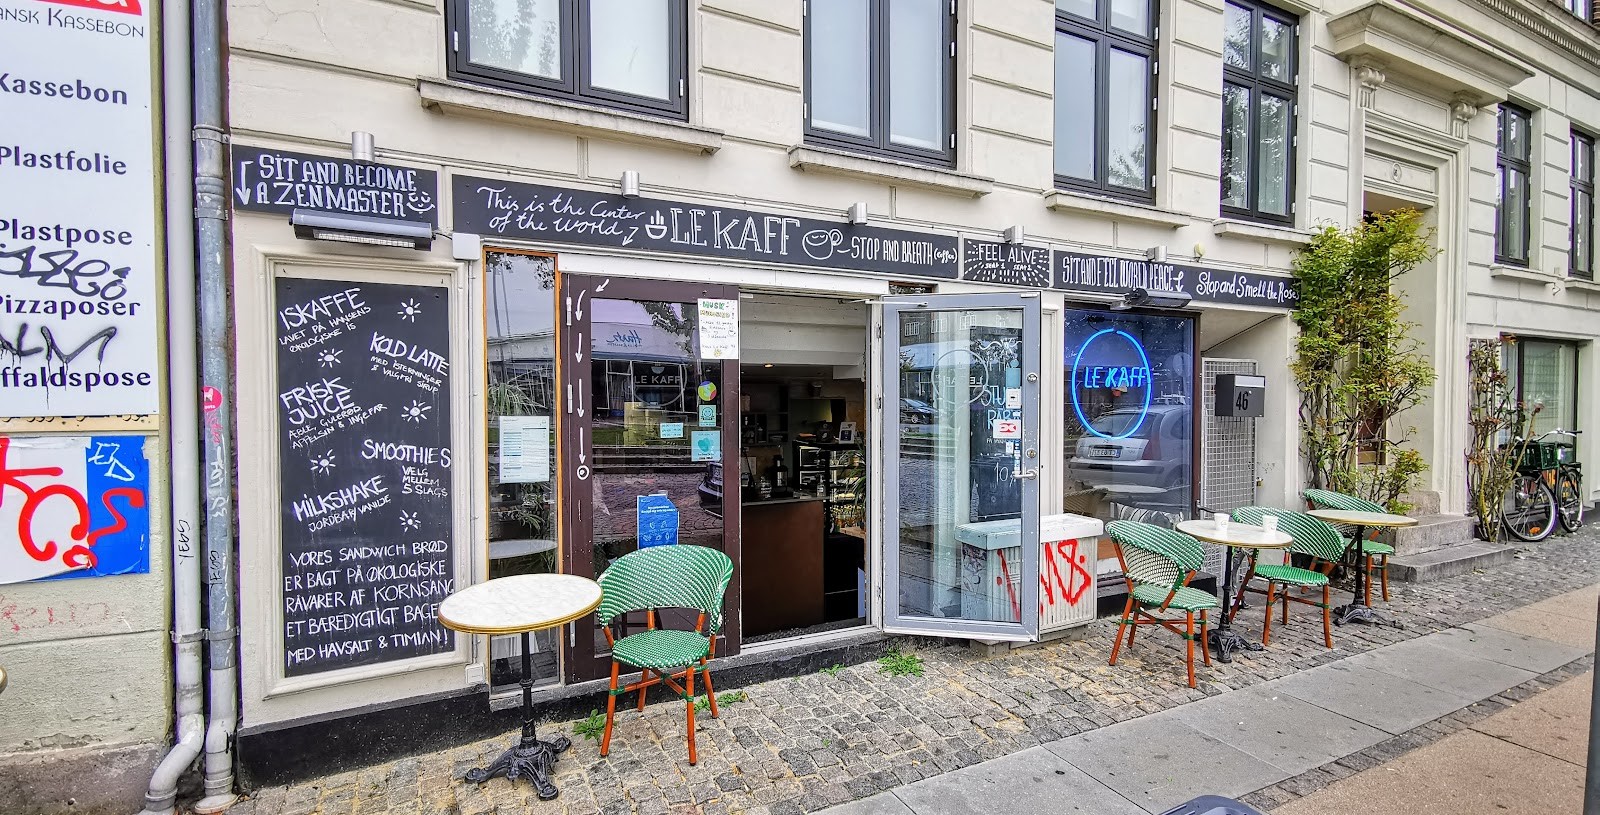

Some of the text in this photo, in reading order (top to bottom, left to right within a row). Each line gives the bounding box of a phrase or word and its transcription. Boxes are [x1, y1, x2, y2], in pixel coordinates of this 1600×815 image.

[0, 7, 40, 24] NSK
[259, 153, 417, 192] SIT AND BECOME
[476, 186, 646, 220] This is the Center
[489, 210, 512, 233] of
[516, 212, 548, 232] the
[670, 207, 801, 255] LE KAFF
[850, 236, 880, 261] STOP
[882, 239, 900, 262] AND
[901, 240, 933, 266] BREATH
[978, 243, 1040, 265] FEEL ALIVE
[1080, 258, 1096, 286] AND
[1119, 260, 1148, 291] WORLD
[1149, 263, 1174, 292] PEACE
[1196, 271, 1300, 304] Stop and Smell the Roses
[0, 295, 140, 320] izzaposer
[279, 288, 366, 331] ISKAFFE
[279, 306, 371, 346] LAVET PÅ HANSENS
[289, 322, 356, 352] ØKOLOGISKE IS
[369, 331, 450, 377] KOLD LATTE
[370, 356, 388, 366] MED
[0, 366, 152, 396] ffaldspose
[416, 380, 439, 393] SIRUP
[634, 375, 681, 384] LE KAFF
[1084, 366, 1148, 388] LE KAFF
[280, 376, 349, 409] FRISK
[288, 389, 355, 425] JUICE
[1235, 390, 1249, 411] 46
[292, 426, 335, 449] APPELSIN
[401, 483, 448, 498] 5 SLAGS
[402, 475, 440, 487] MELLEM
[293, 475, 389, 522] MILKSHAKE
[290, 540, 448, 567] VORES SANDWICH BRØD
[285, 560, 447, 592] ER BAGT PÅ ØKOLOGISKE
[286, 591, 346, 614] RÅVARER
[350, 589, 366, 606] AF
[287, 620, 306, 638] ET
[308, 606, 400, 635] BÆREDYGTIGT
[287, 647, 316, 667] MED
[319, 639, 373, 659] HAVSALT
[377, 635, 388, 649] &
